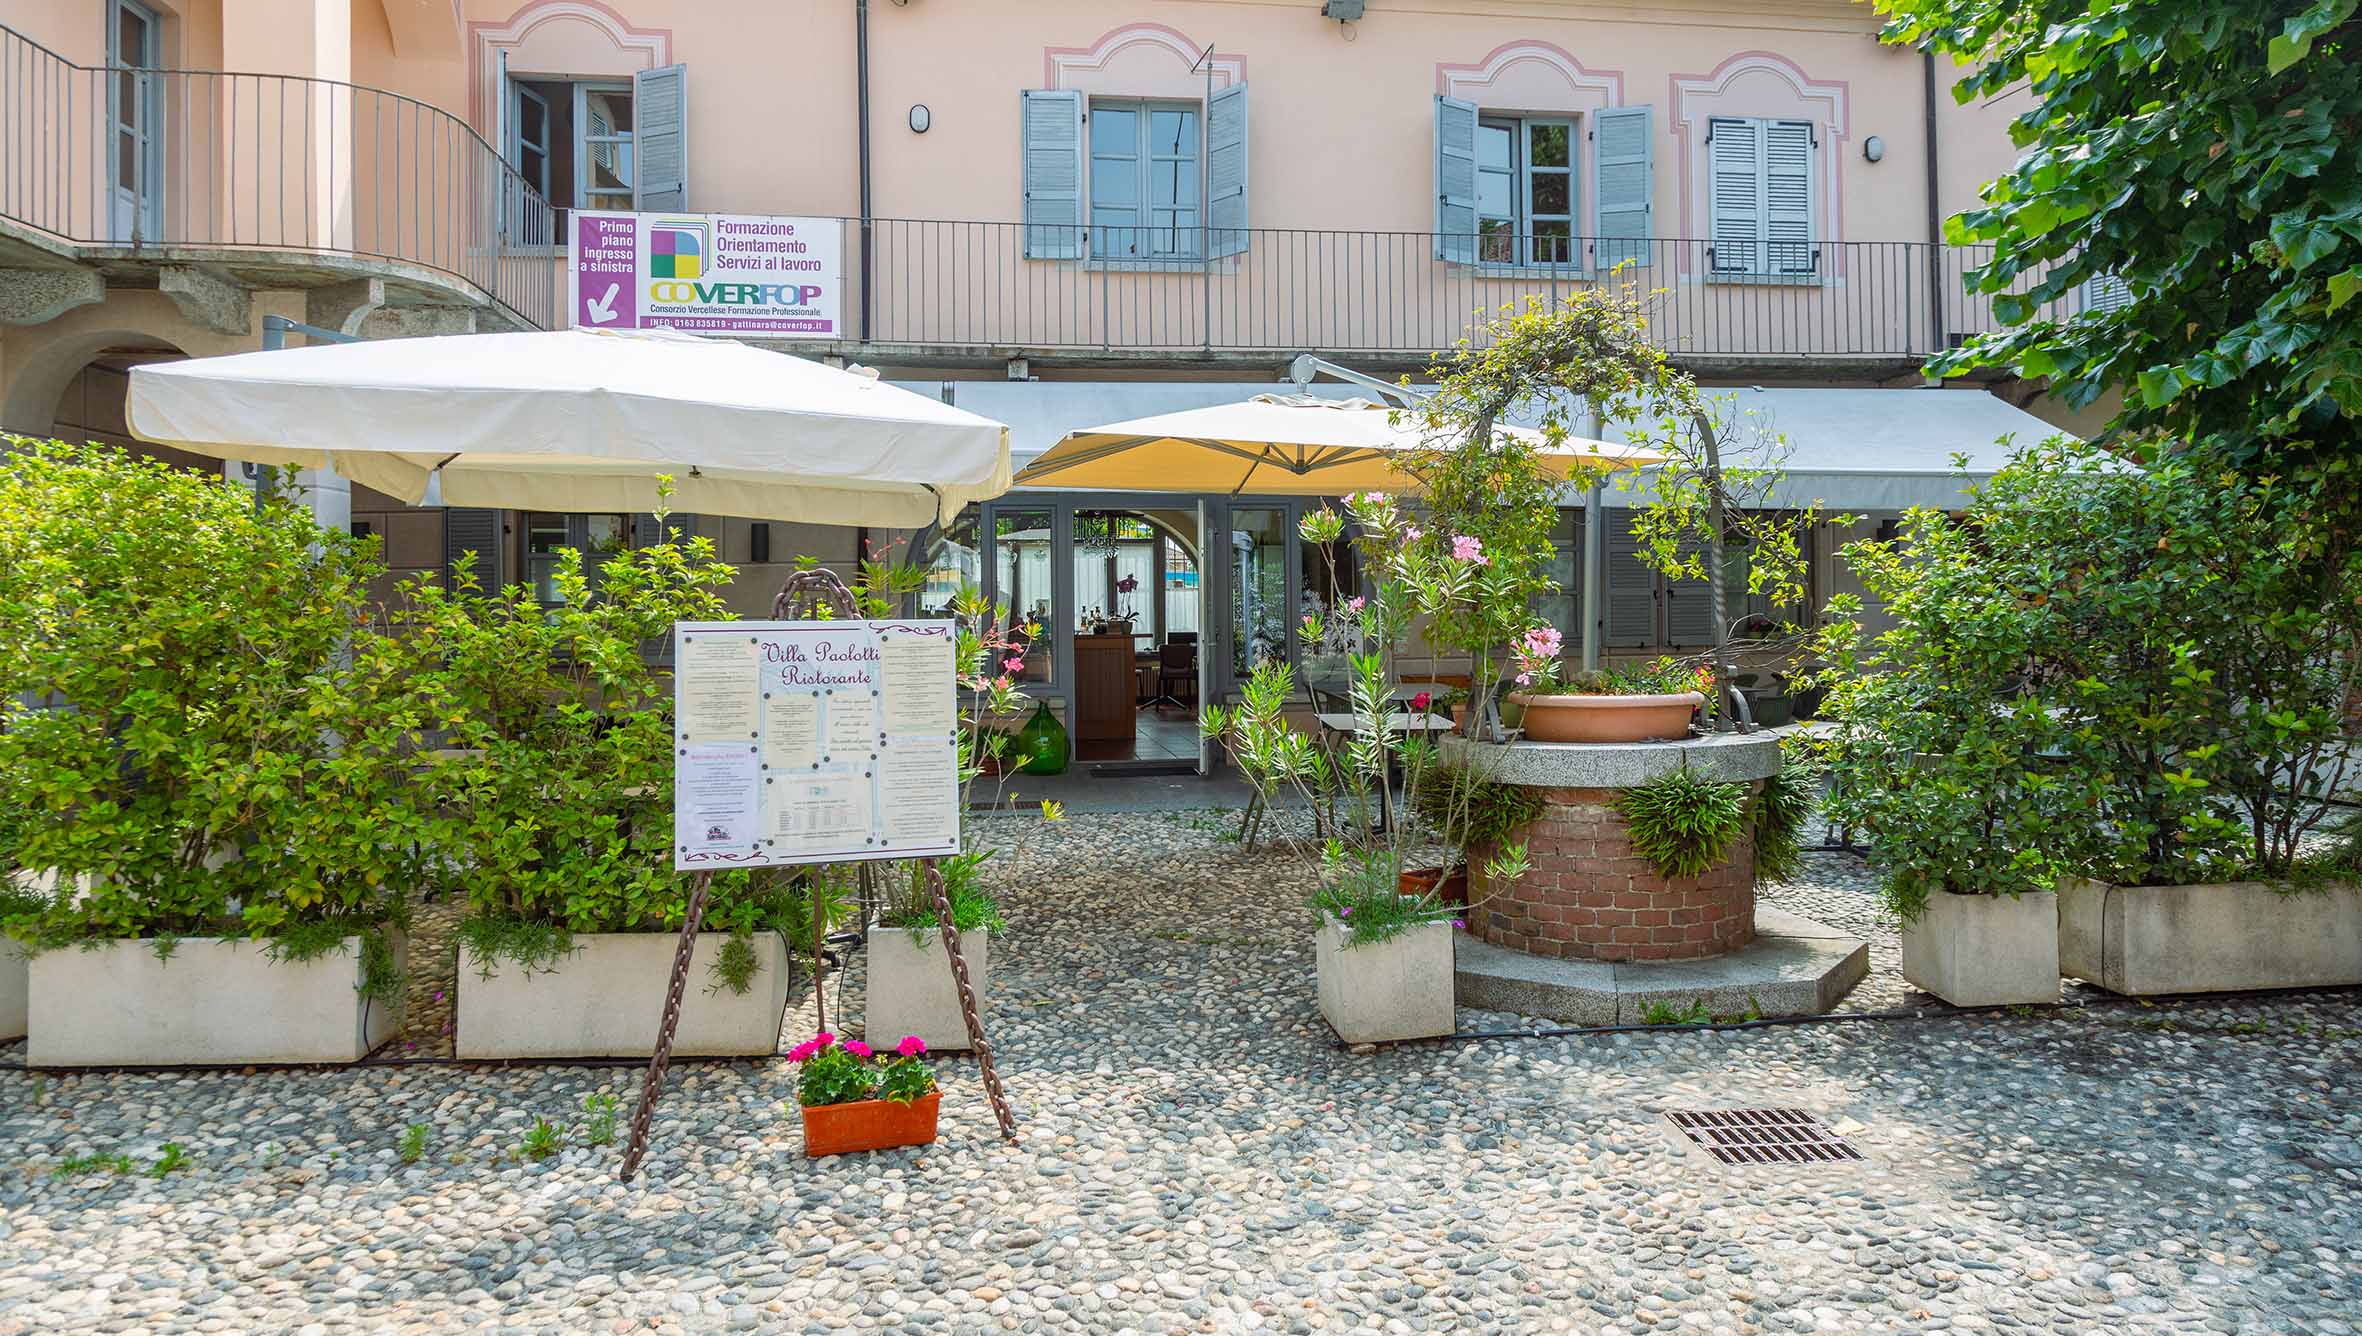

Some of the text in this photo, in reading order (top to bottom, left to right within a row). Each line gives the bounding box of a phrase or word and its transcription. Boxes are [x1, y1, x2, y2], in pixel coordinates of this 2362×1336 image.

[599, 221, 633, 233] Primo
[717, 220, 794, 236] Formazione
[601, 234, 633, 248] piano
[717, 237, 807, 253] Orientamento
[584, 247, 634, 260] ingresso
[580, 260, 633, 272] a sinistra
[717, 255, 821, 272] Servizi al lavoro
[650, 282, 822, 305] COVERFOP
[650, 304, 821, 317] Consorzio Vercellese Formazione Professionale
[674, 319, 695, 327] 0163
[696, 320, 726, 328] 835819
[732, 320, 822, 331] gattinara@coverfop.it
[761, 641, 880, 663] Villa Paolotti
[781, 664, 872, 686] Ristorante
